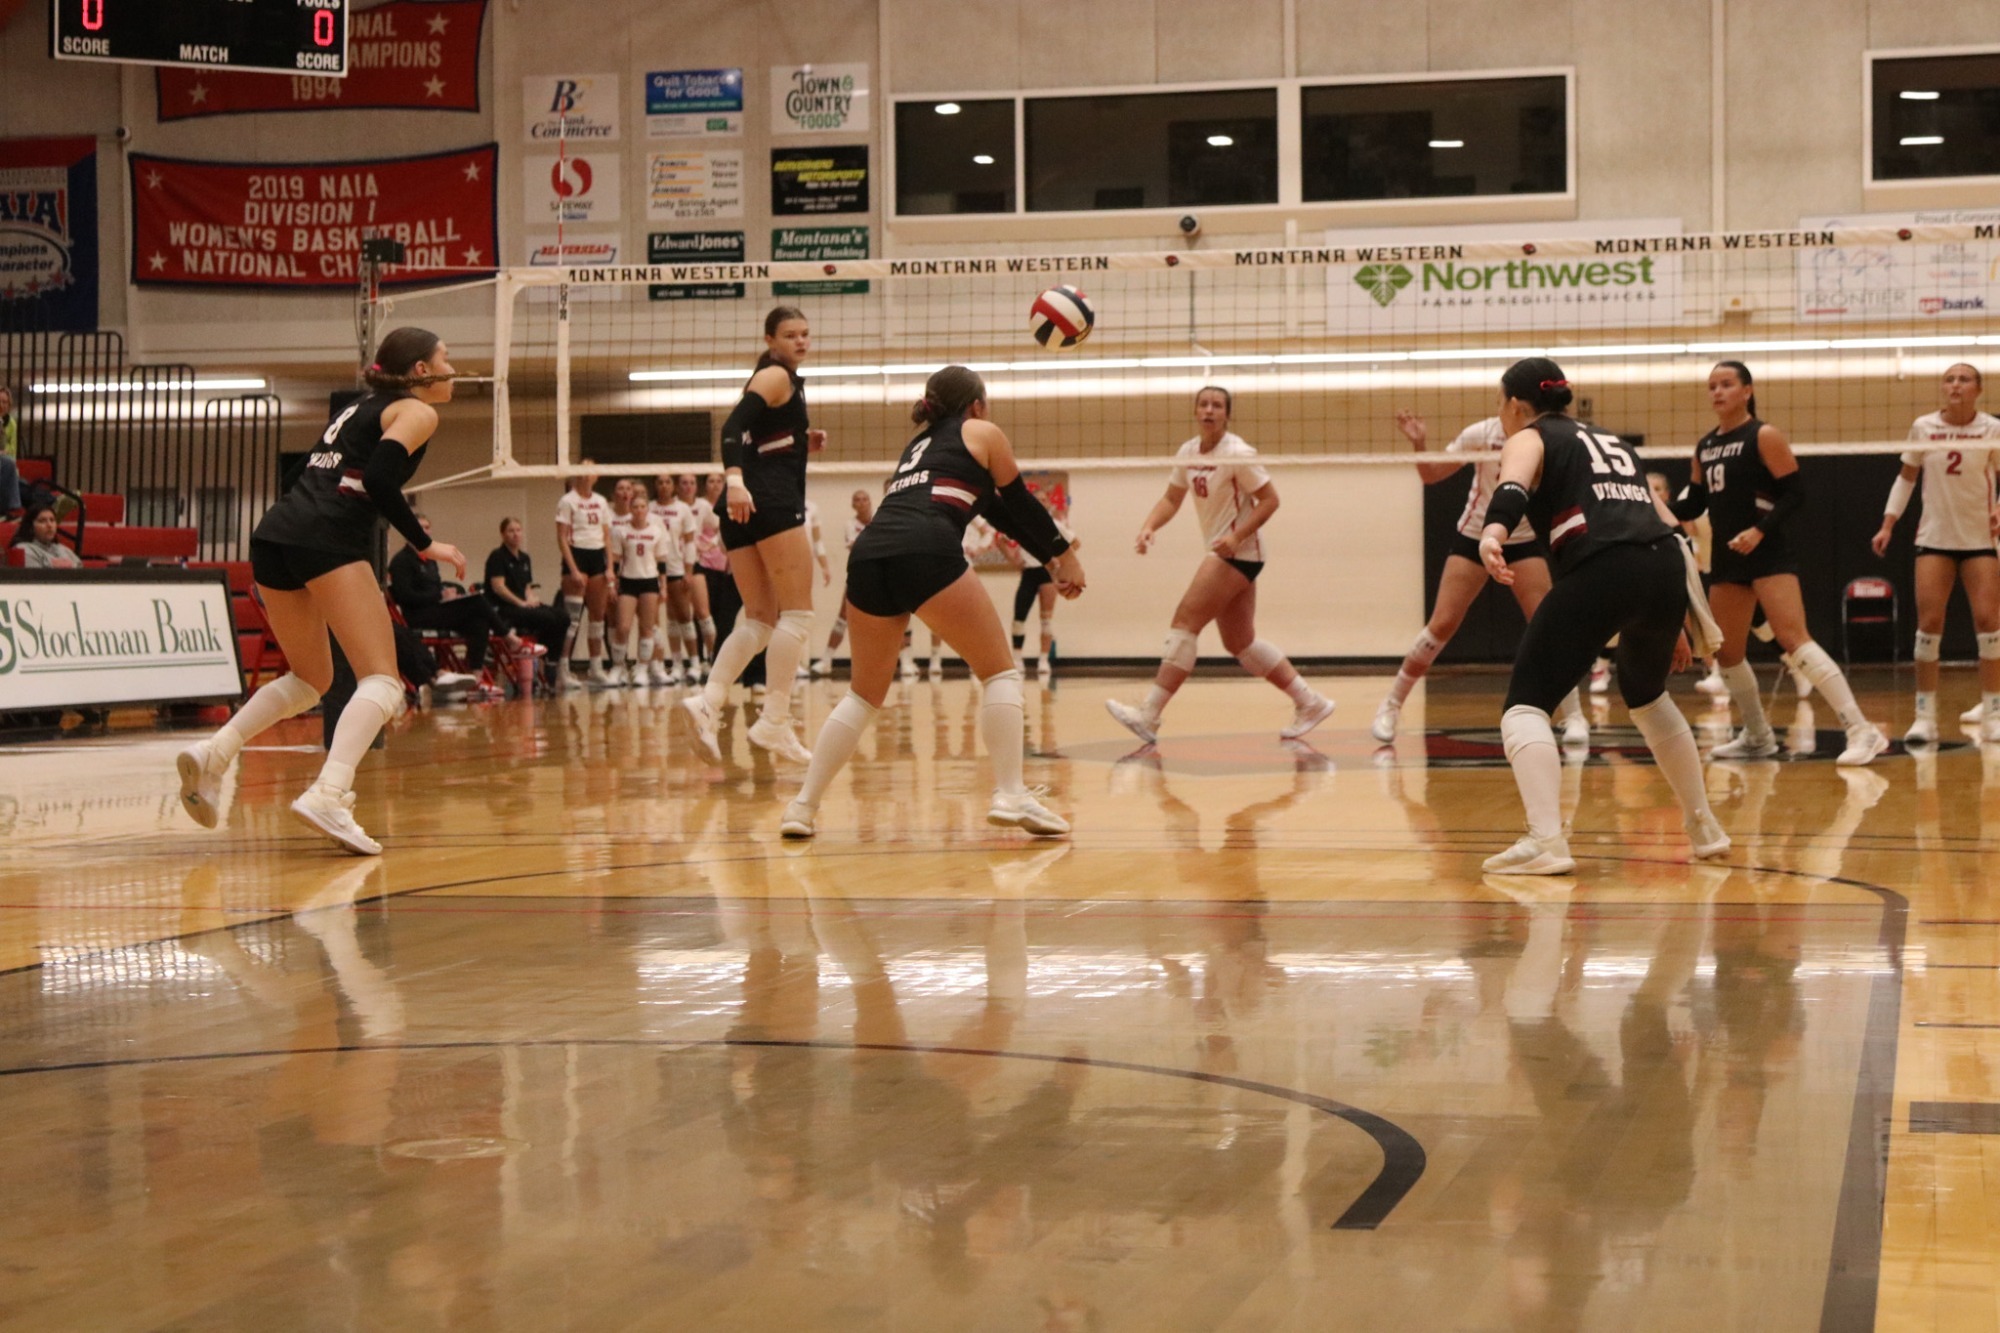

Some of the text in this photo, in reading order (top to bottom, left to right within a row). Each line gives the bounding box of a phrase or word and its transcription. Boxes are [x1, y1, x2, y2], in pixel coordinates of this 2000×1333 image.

[313, 9, 334, 47] 0
[63, 36, 110, 56] SCORE
[179, 43, 229, 63] MATCH
[350, 41, 442, 69] AMPIONS
[296, 52, 340, 71] SCORE
[291, 76, 342, 100] 1994
[792, 71, 840, 95] TOWN
[785, 89, 852, 120] COUNTRY
[800, 112, 841, 130] FOODS
[248, 173, 379, 200] 2019 NAIA
[244, 200, 353, 225] DIVISION
[169, 221, 277, 251] WOMEN'S
[780, 228, 863, 246] Montana's
[1595, 231, 1835, 253] MONTANA WESTERN
[0, 242, 48, 259] mpions
[1235, 245, 1463, 265] MONTANA WESTERN
[183, 249, 306, 278] NATIONAL
[671, 265, 769, 281] WESTERN
[890, 256, 1109, 275] MONTANA WESTERN
[1423, 256, 1654, 291] Northwest
[323, 403, 359, 445] 8
[899, 436, 932, 473] 3
[1576, 430, 1636, 476] 15
[1946, 451, 1962, 476] 2
[1706, 463, 1725, 493] 19
[1592, 481, 1651, 503] VIKINGS
[14, 598, 223, 660] Stockman Bank
